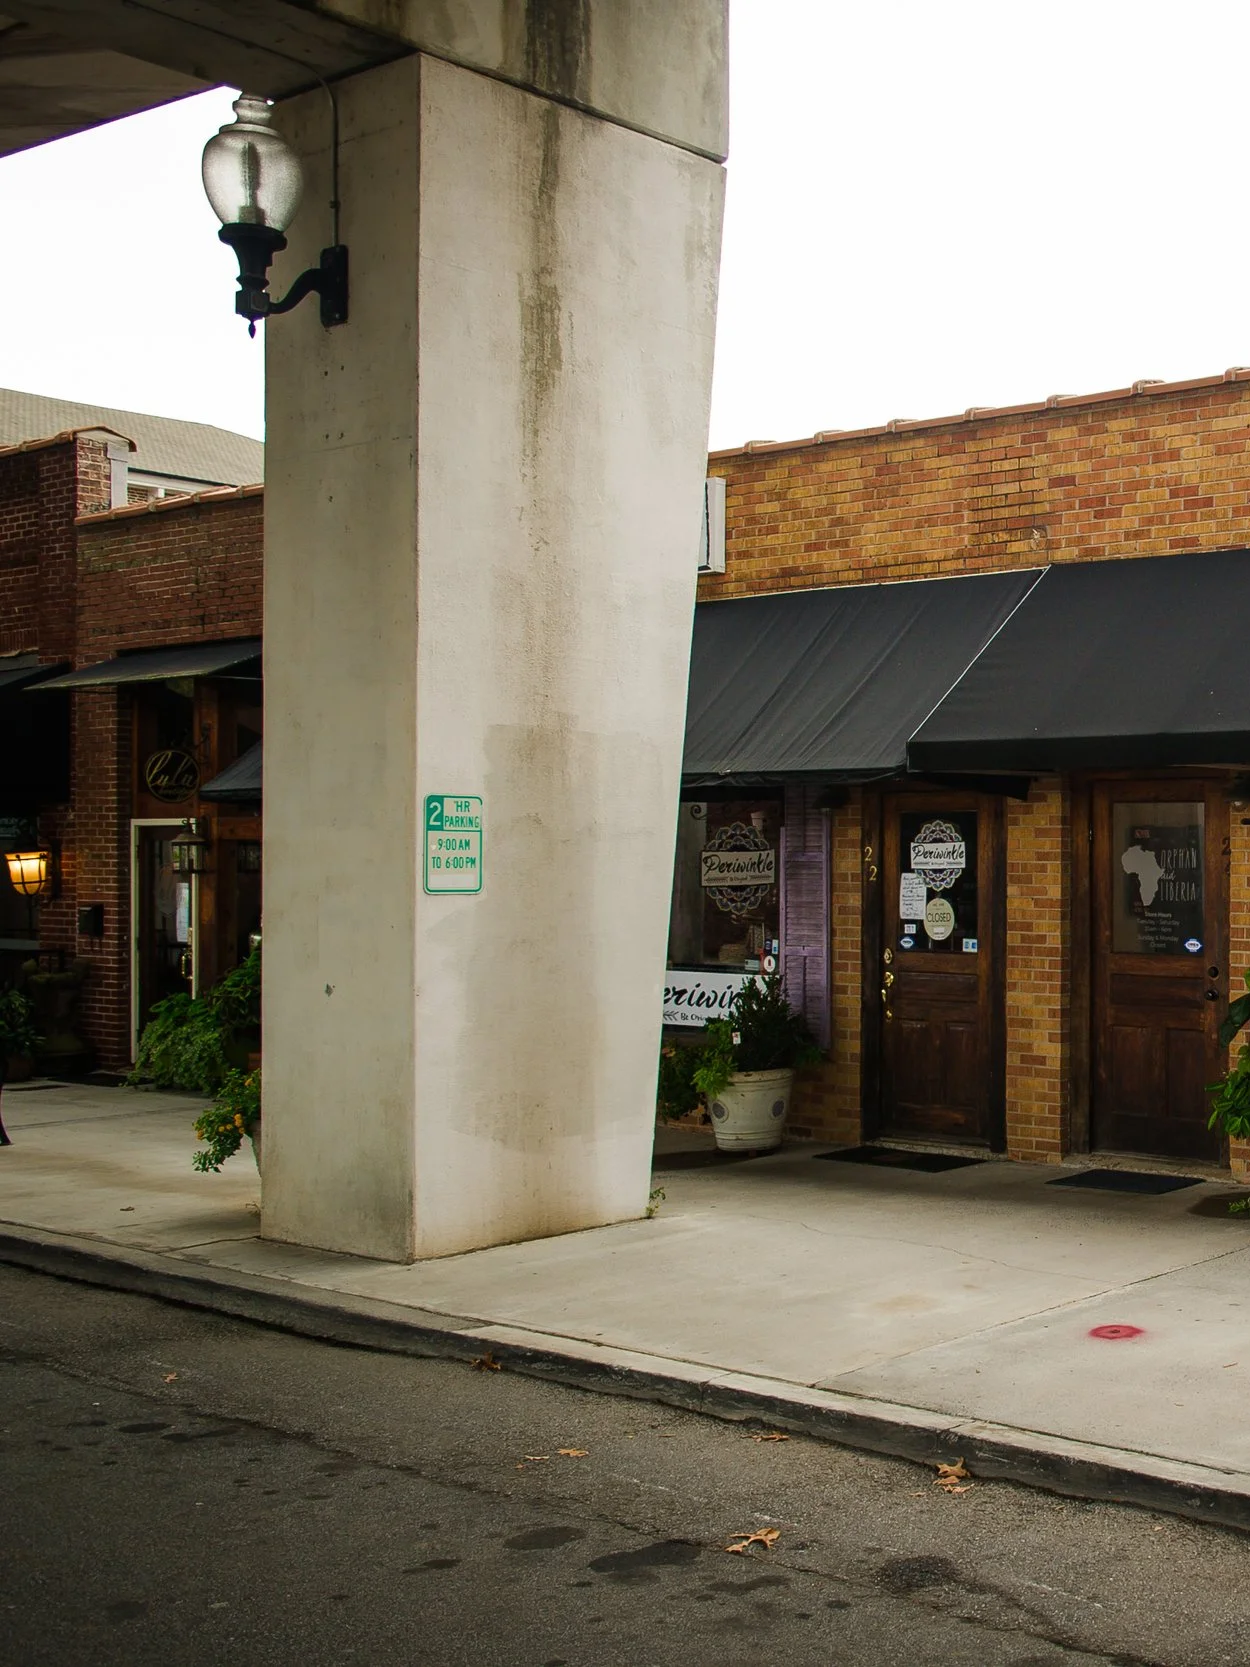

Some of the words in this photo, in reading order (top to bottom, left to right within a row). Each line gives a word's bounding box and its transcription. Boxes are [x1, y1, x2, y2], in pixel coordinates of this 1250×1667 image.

[429, 801, 442, 826] 2
[454, 801, 471, 812] HR
[444, 815, 480, 828] PARKING
[437, 838, 457, 851] 9:00
[458, 838, 471, 851] AM
[912, 843, 965, 860] Periwinkle
[431, 856, 441, 868] TO
[702, 852, 774, 876] Periwinkle
[1160, 848, 1197, 869] ORPHAN
[1160, 881, 1196, 901] LIBERIA
[927, 912, 951, 923] CLOSED
